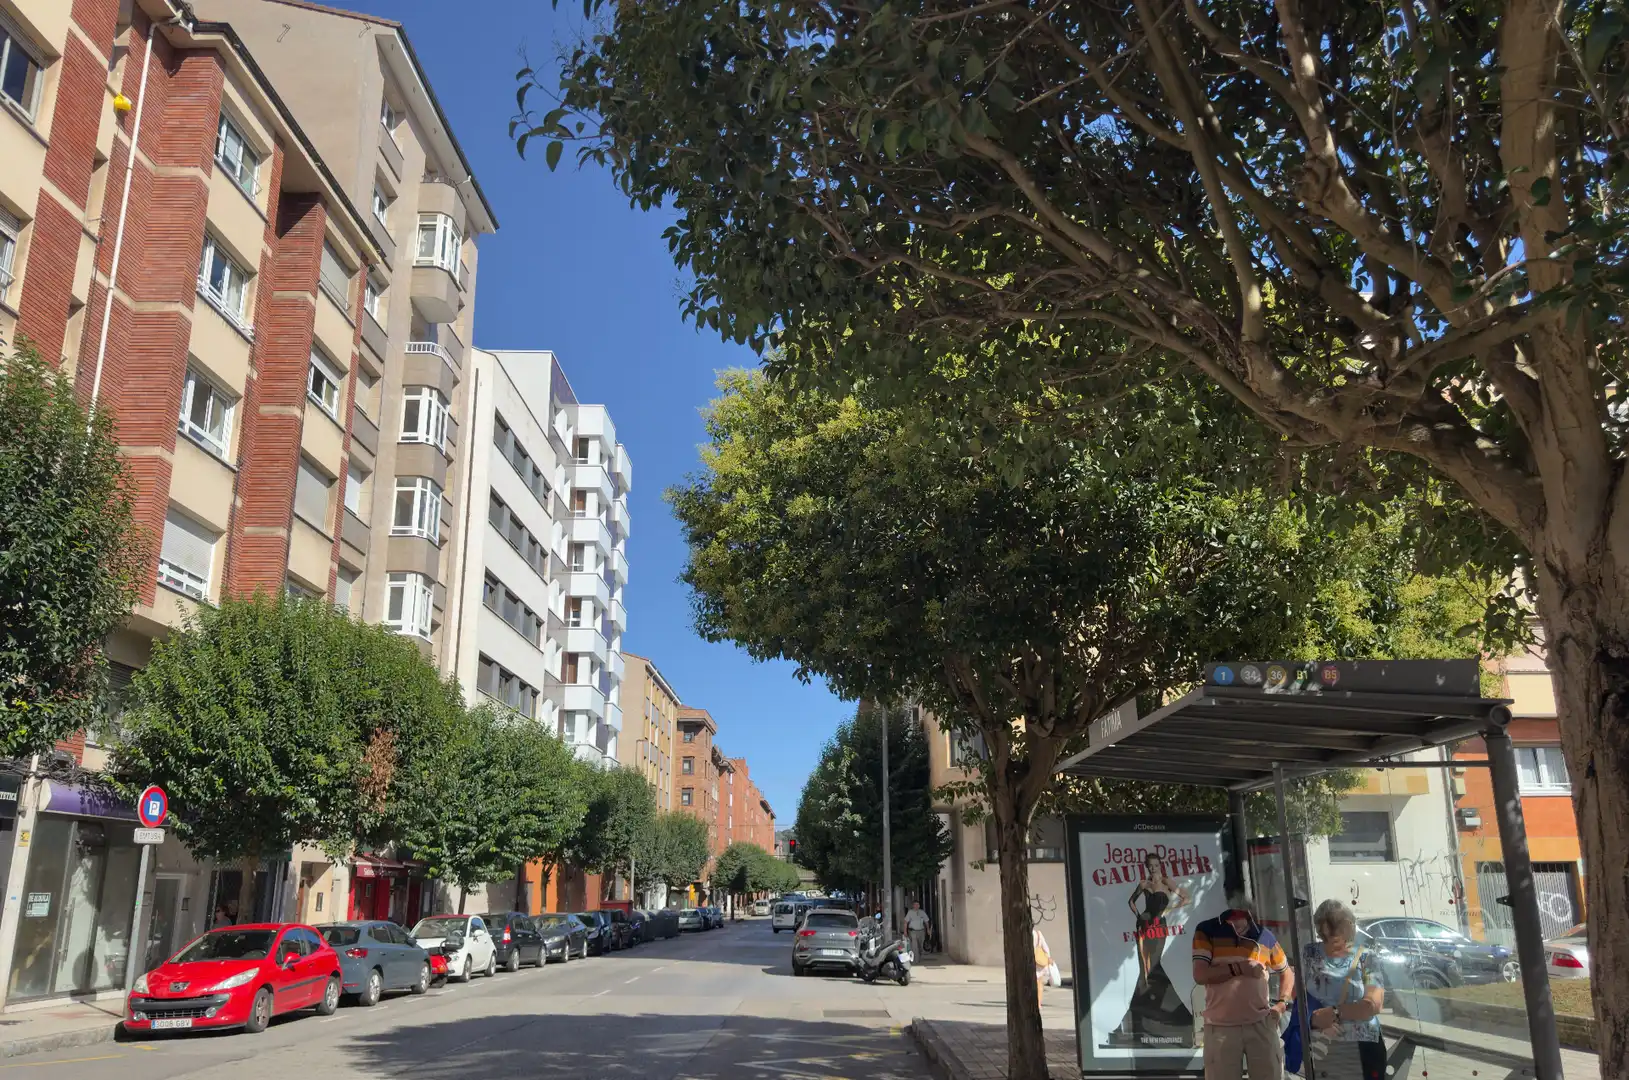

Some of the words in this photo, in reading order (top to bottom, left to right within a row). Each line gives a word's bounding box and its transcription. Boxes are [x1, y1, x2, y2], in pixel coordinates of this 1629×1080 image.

[1220, 671, 1226, 681] 1
[1244, 670, 1258, 680] 34
[1270, 670, 1282, 680] 36
[1296, 670, 1308, 680] B1
[1324, 669, 1337, 680] B5
[151, 802, 158, 814] P
[1133, 823, 1166, 831] JCDecaux
[1103, 842, 1148, 864] Jean
[1154, 844, 1200, 864] Paul
